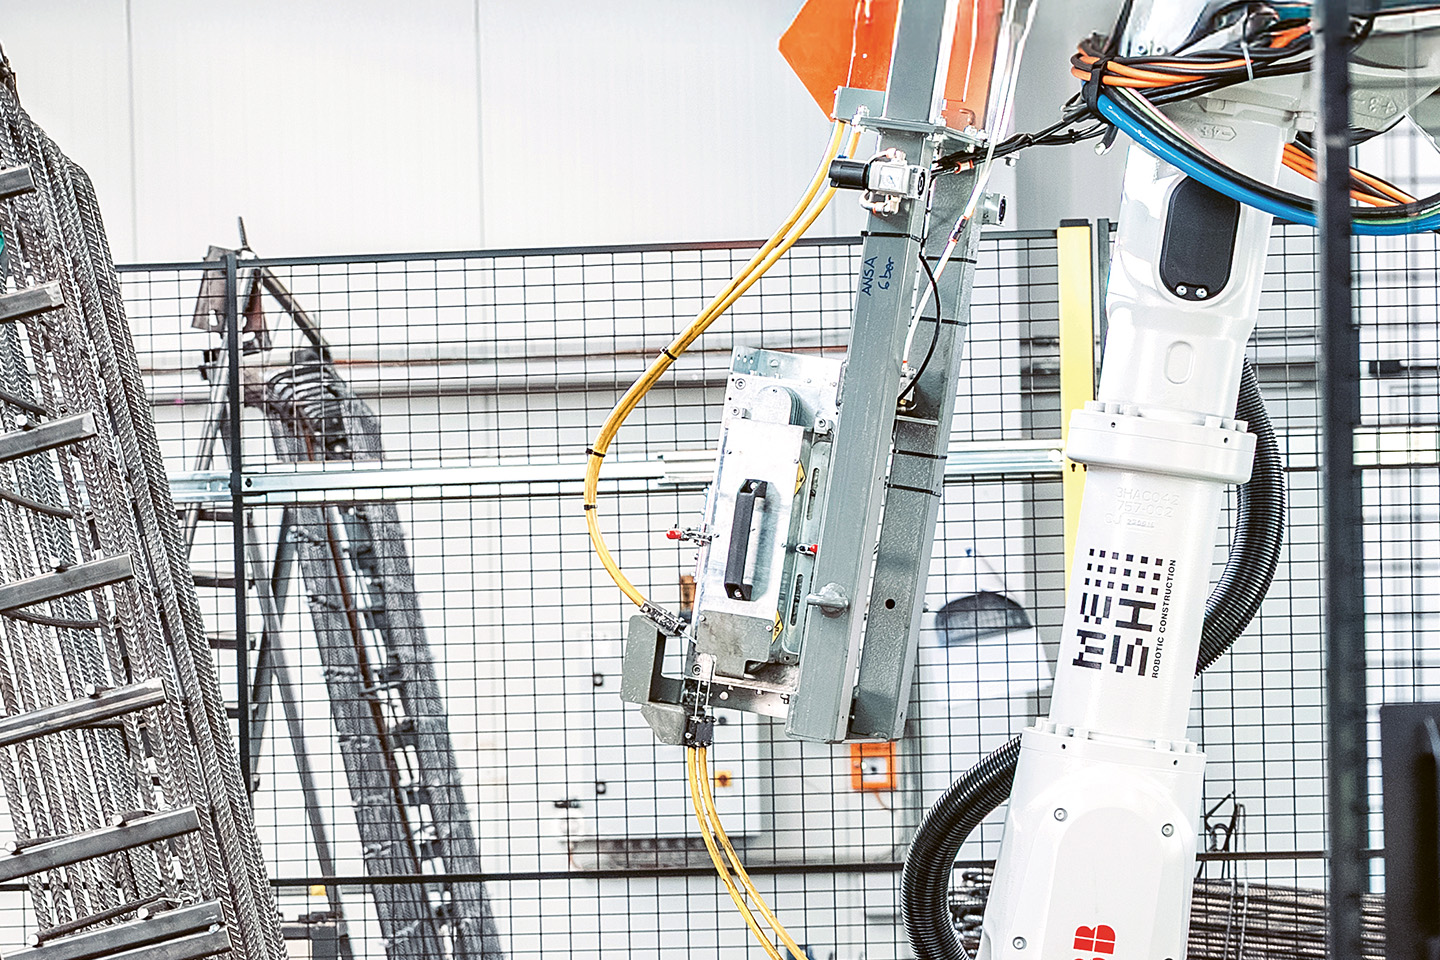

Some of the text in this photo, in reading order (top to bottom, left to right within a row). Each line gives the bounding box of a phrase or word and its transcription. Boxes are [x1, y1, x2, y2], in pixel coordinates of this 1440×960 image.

[861, 256, 878, 296] ANSA
[1151, 559, 1177, 679] ROBOTIC CONSTRUCTION
